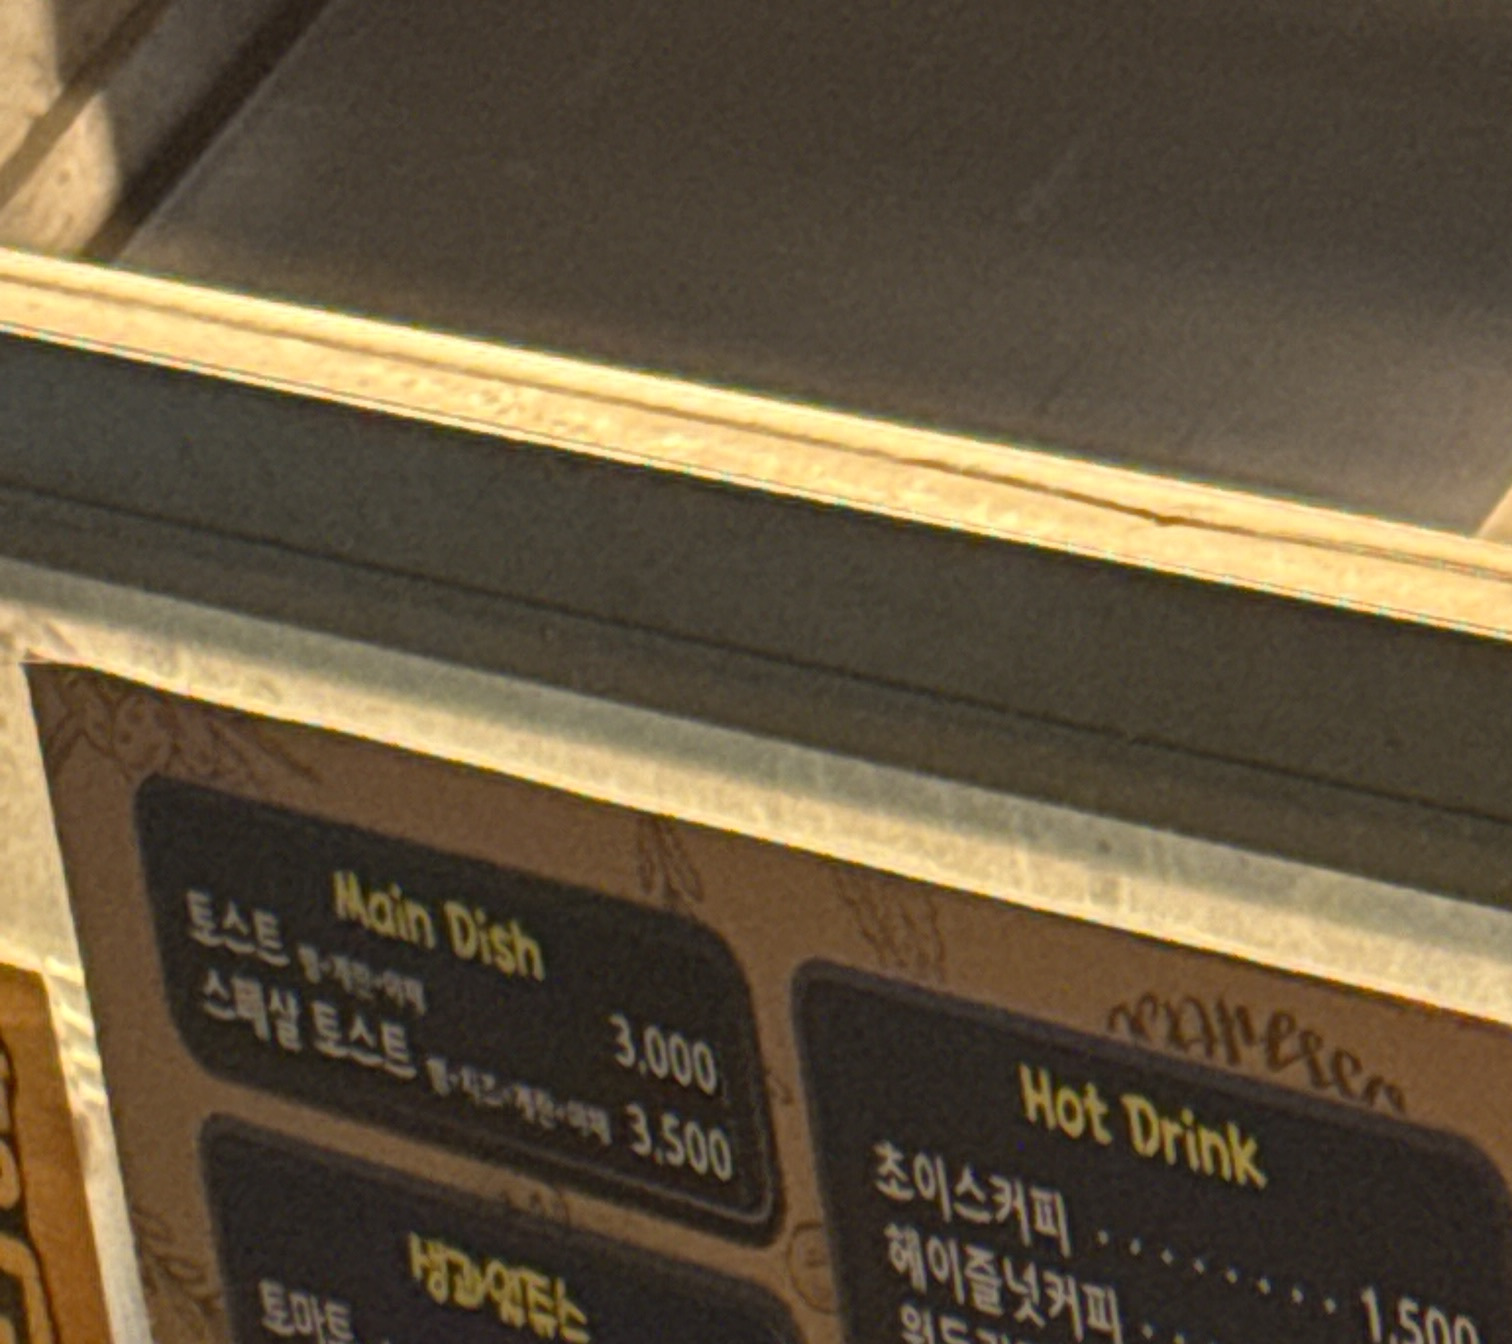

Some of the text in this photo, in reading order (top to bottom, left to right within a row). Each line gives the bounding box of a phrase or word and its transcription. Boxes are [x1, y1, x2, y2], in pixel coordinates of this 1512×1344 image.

[334, 870, 545, 981] Main Dish
[187, 890, 290, 966] 토스트
[611, 1016, 715, 1092] 3,000
[312, 1001, 418, 1081] 토스트
[628, 1105, 730, 1178] 3,500
[1019, 1062, 1268, 1189] Hot Drink
[873, 1140, 1071, 1258] 초이스커피
